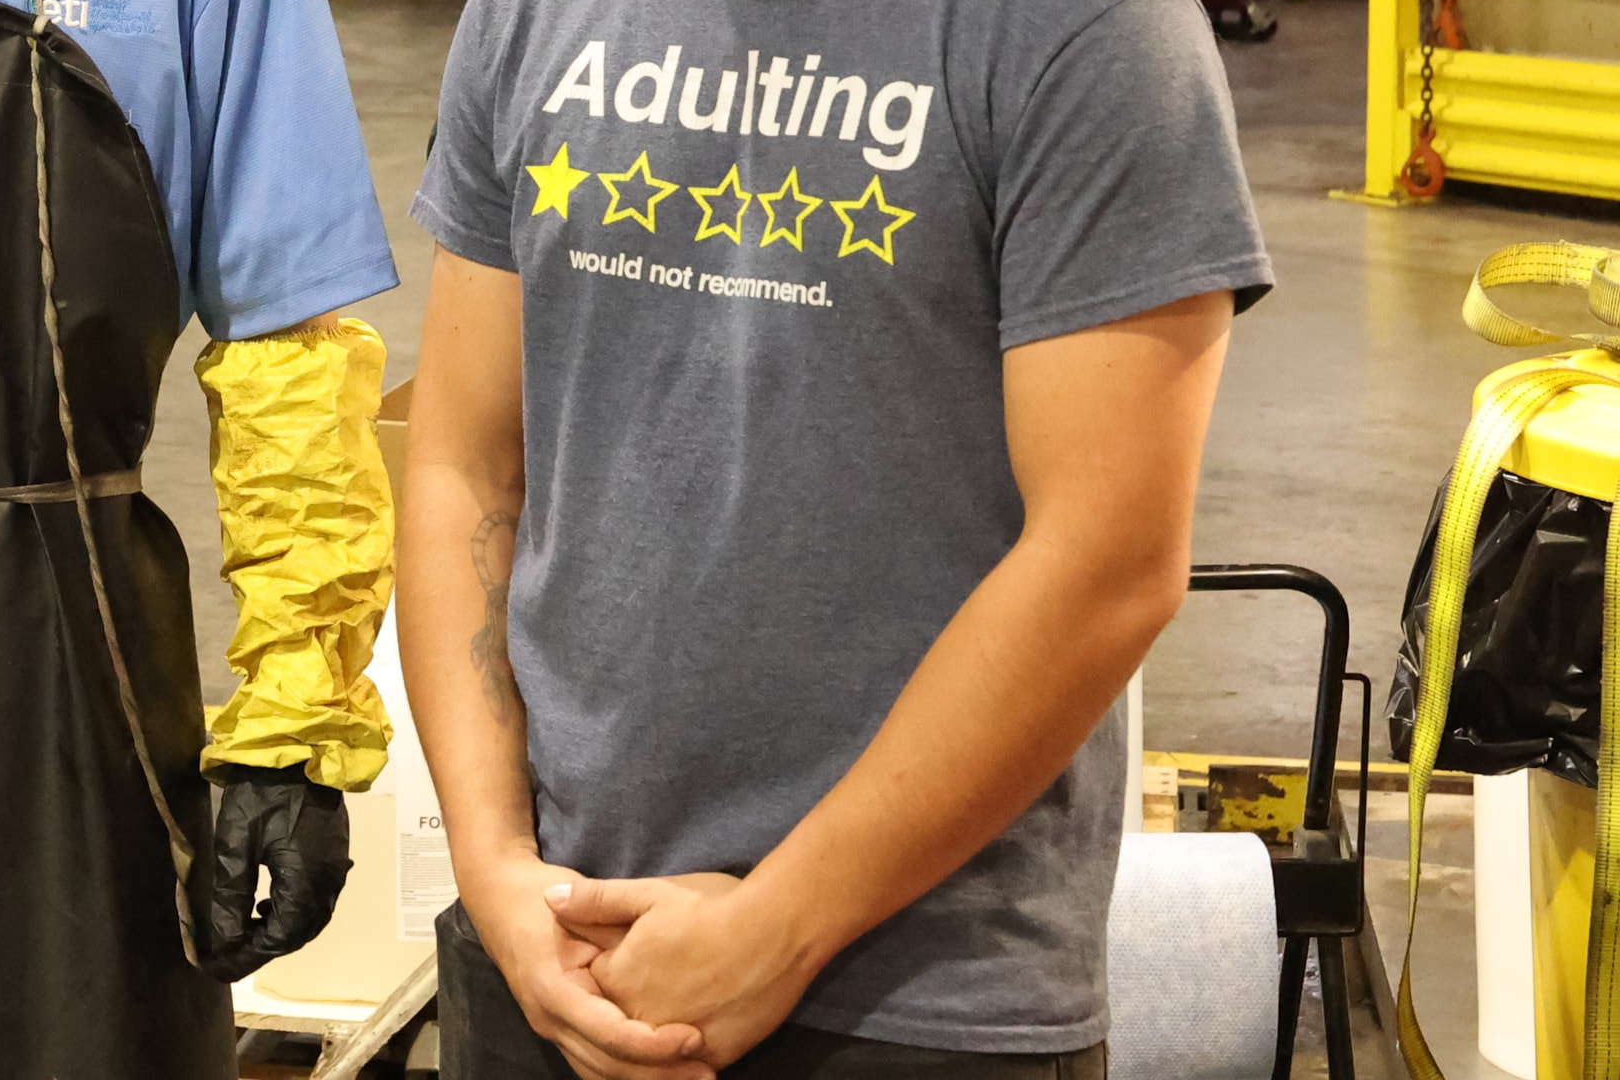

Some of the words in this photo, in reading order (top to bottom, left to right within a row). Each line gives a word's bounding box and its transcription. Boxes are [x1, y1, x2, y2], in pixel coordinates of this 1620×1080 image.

[542, 40, 934, 171] Adulting
[569, 249, 643, 281] would
[649, 263, 693, 290] not
[698, 272, 833, 308] recommend.
[419, 816, 446, 829] FO
